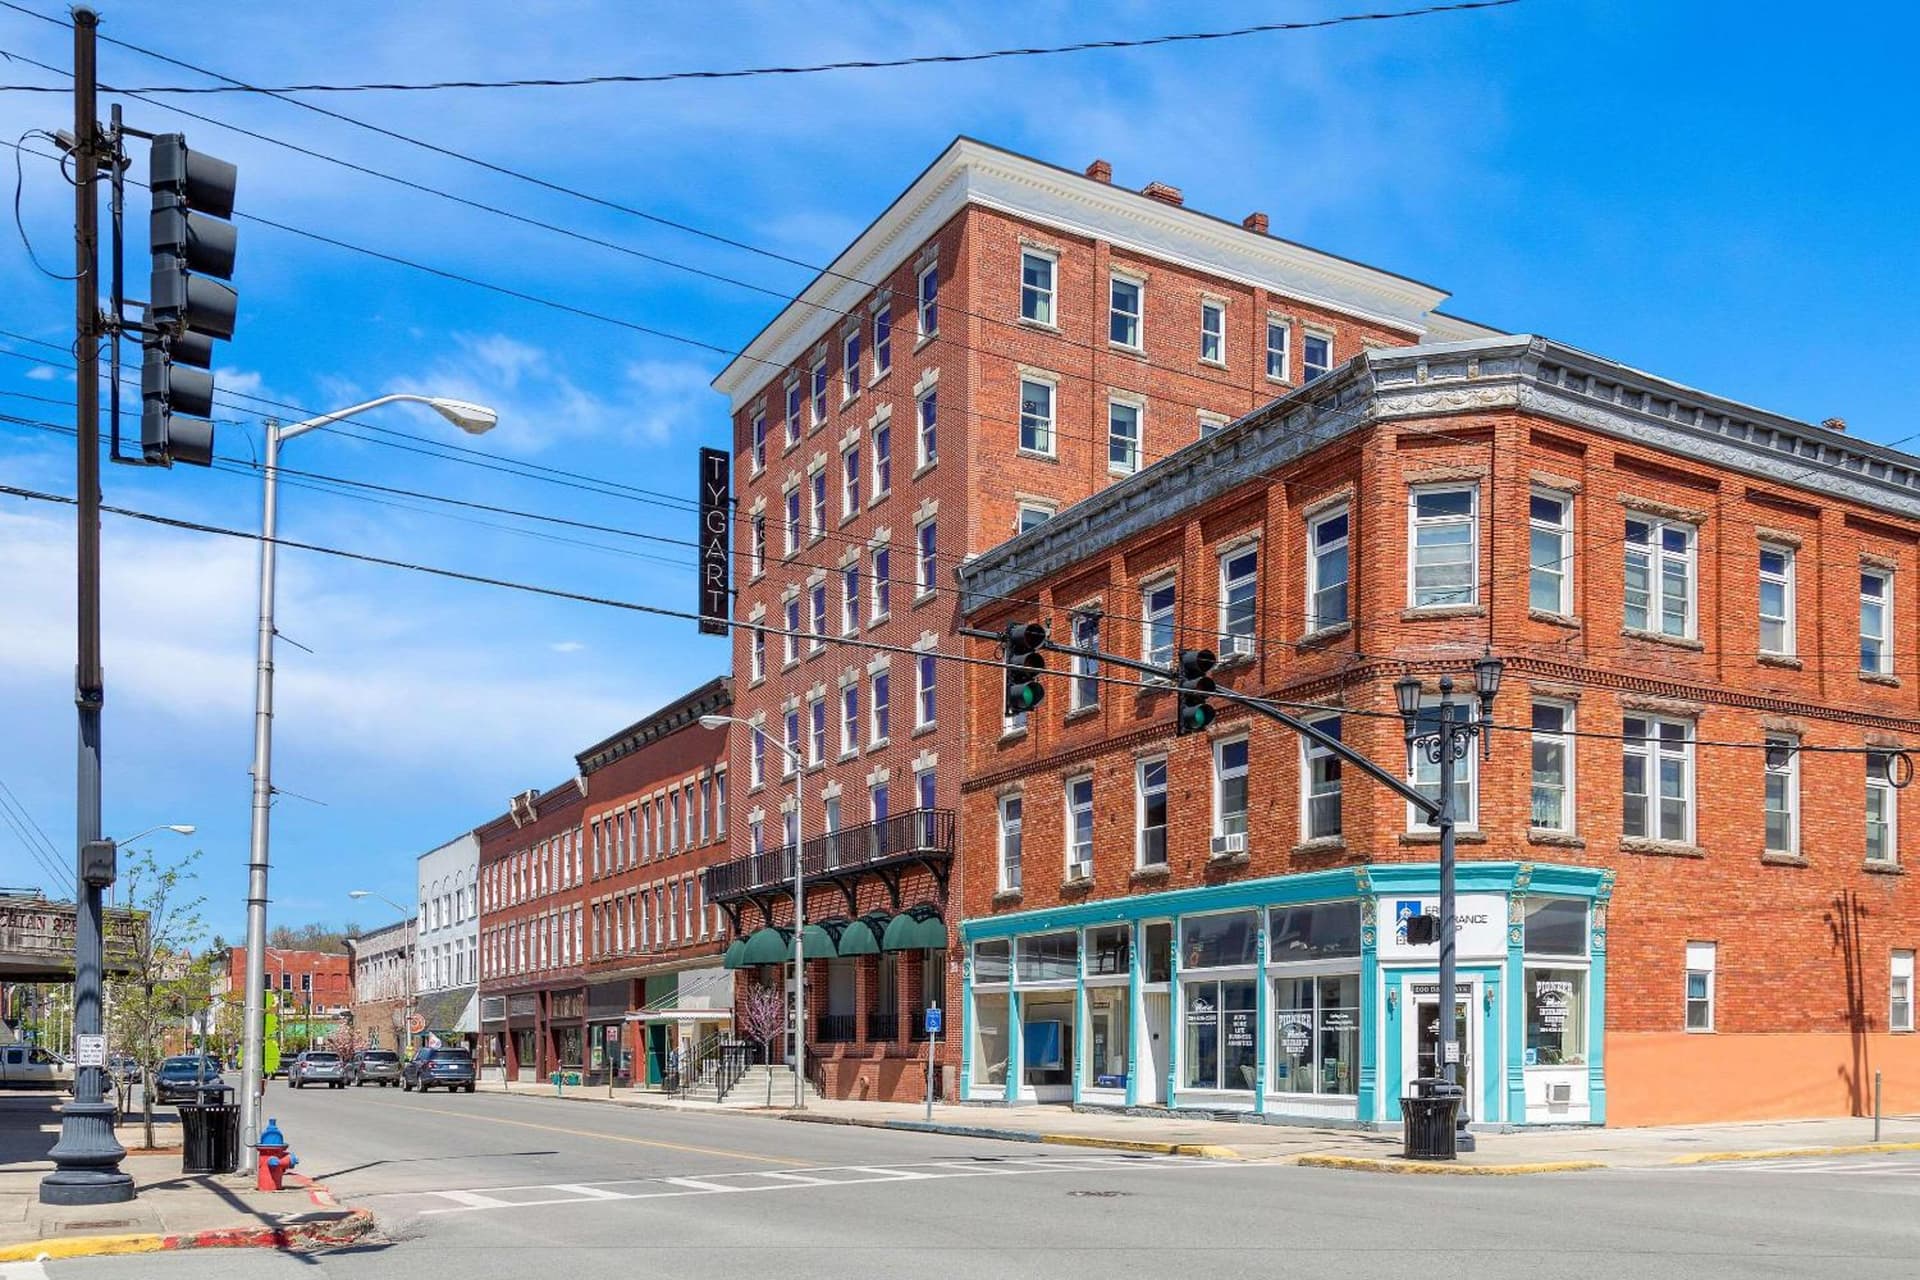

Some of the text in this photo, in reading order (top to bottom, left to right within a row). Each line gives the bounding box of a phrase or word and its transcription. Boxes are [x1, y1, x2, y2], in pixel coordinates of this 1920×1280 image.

[705, 456, 727, 613] TYGART
[1535, 981, 1573, 999] PIONEER
[1278, 1014, 1313, 1030] PIONEER
